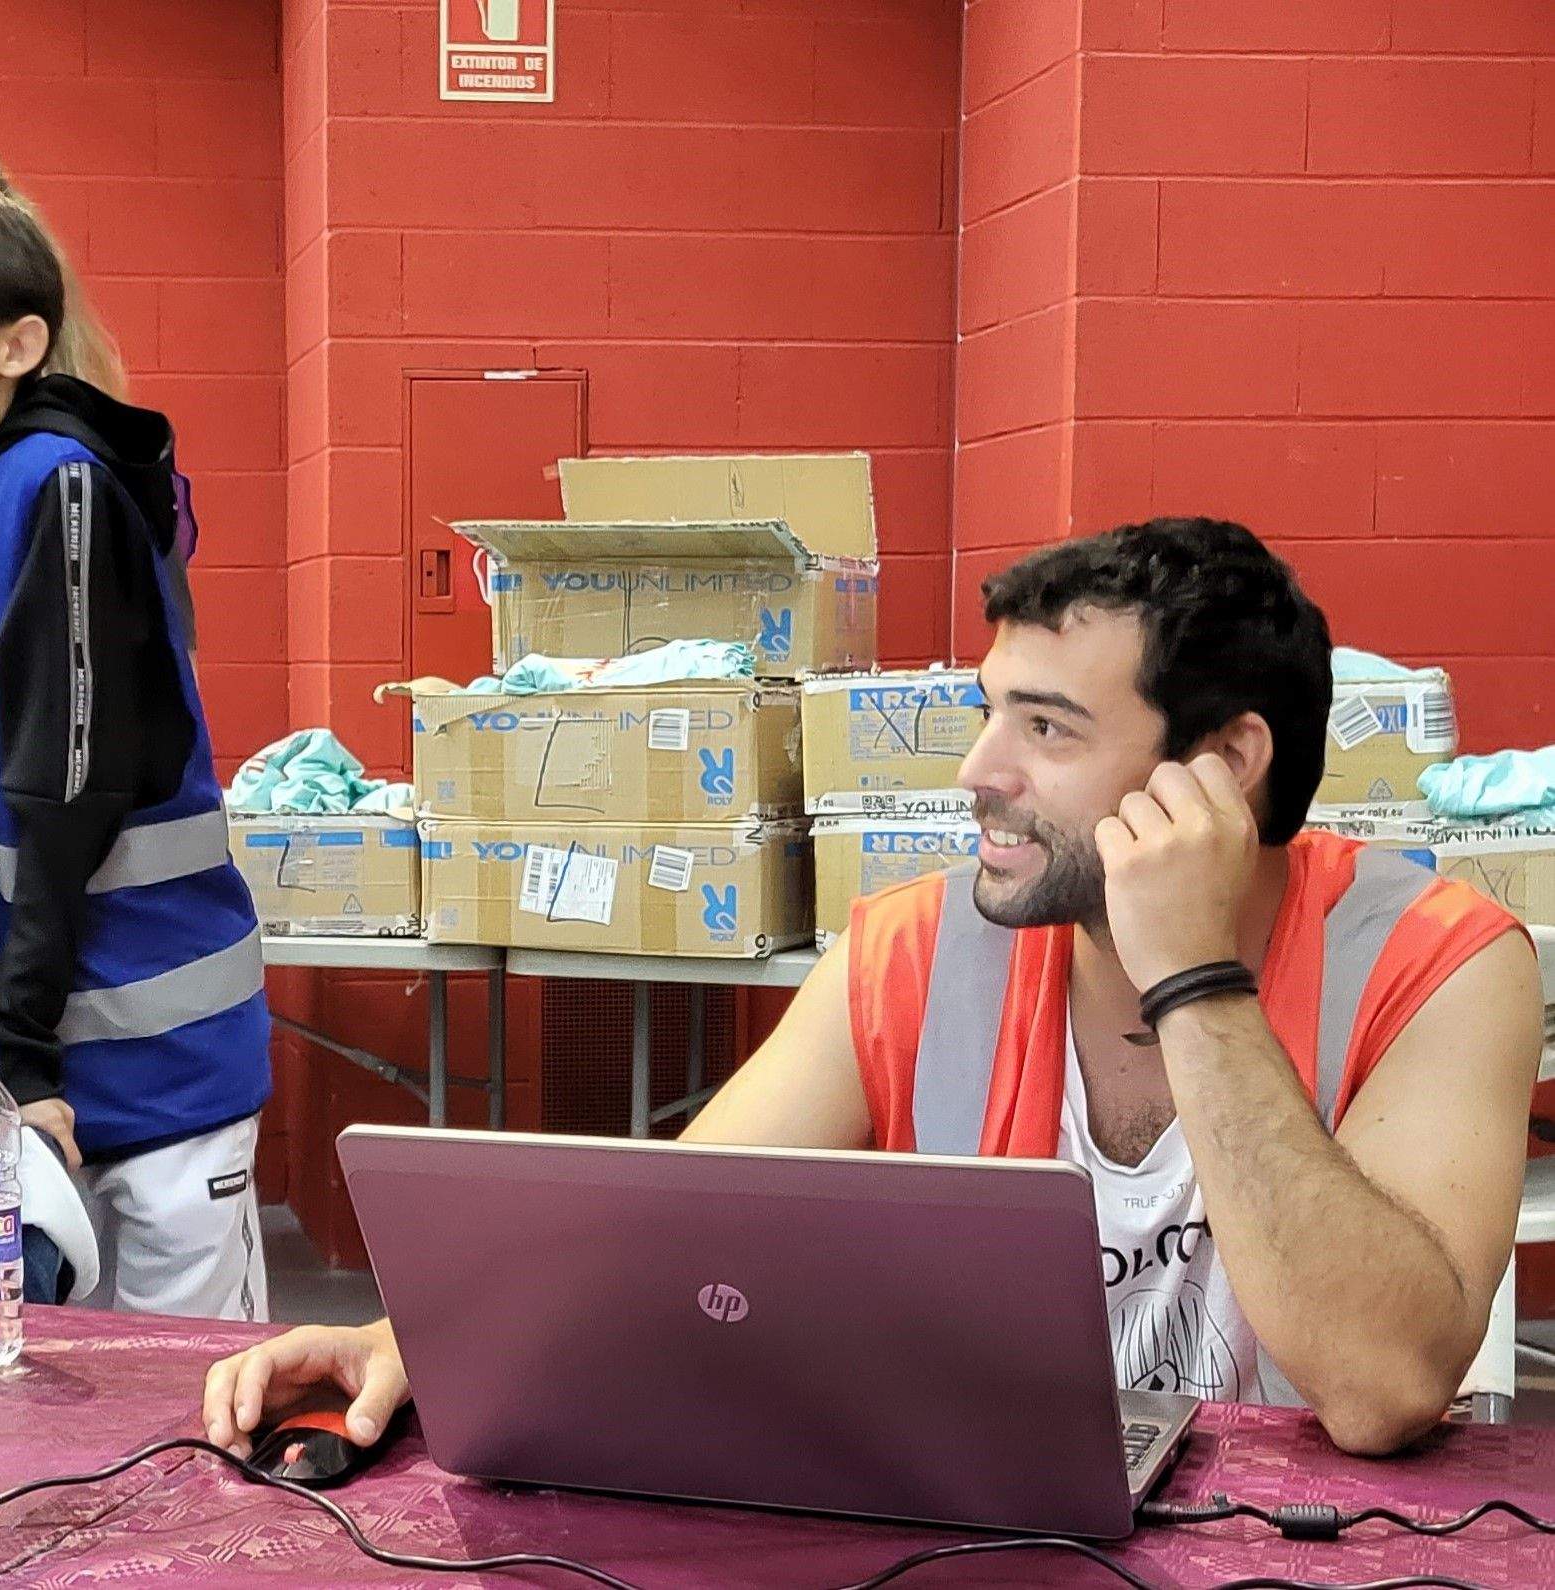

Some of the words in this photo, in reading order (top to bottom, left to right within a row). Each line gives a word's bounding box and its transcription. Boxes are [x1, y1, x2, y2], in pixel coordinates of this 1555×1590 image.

[451, 55, 517, 70] EXTINTOR
[524, 57, 544, 71] DE
[458, 73, 536, 89] INCENDIOS
[763, 653, 790, 664] ROLY
[707, 796, 734, 807] ROLY
[893, 832, 976, 854] ROLY
[710, 932, 737, 942] ROLY
[1123, 1195, 1159, 1209] TRUE
[706, 1284, 742, 1321] hp
